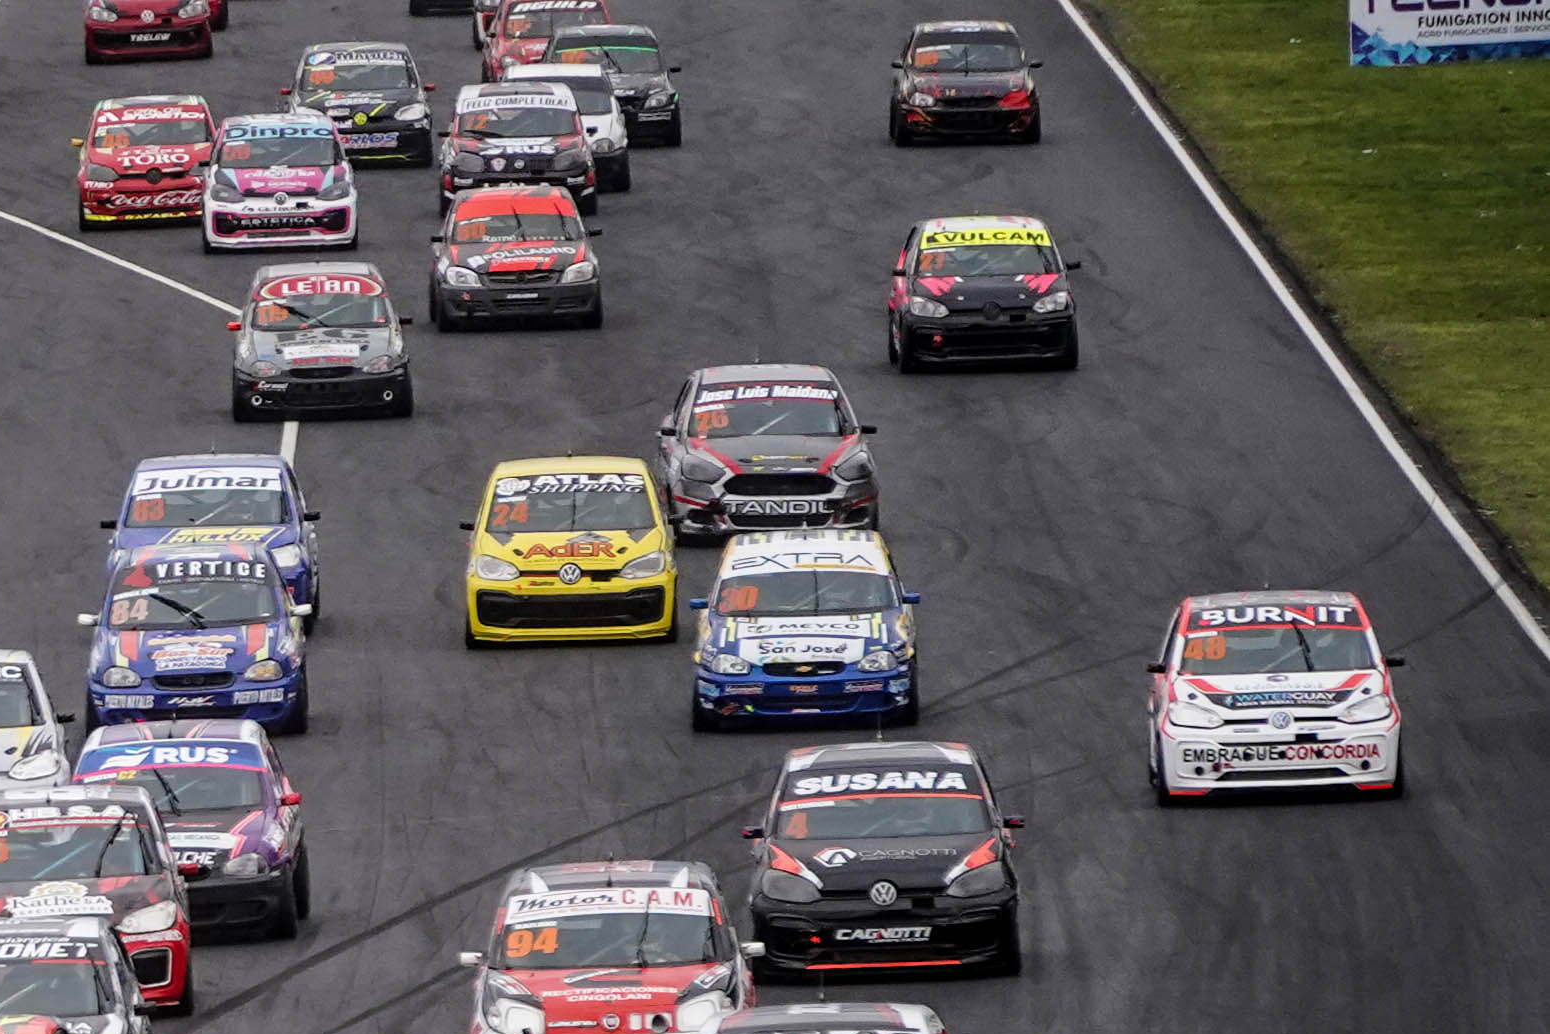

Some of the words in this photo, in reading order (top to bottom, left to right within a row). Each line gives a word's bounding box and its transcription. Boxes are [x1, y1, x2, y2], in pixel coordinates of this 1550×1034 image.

[1418, 10, 1510, 28] FUMIGATION
[495, 97, 536, 106] CUMPLE
[226, 125, 334, 138] Dinpro
[506, 145, 556, 154] RUS
[116, 153, 190, 167] TORO
[84, 181, 114, 189] TORO
[943, 232, 1044, 242] VULCAM
[697, 389, 734, 403] Jose
[736, 386, 770, 399] Luis
[534, 475, 644, 485] ATLAS
[528, 483, 643, 494] SHIPPING
[492, 503, 528, 526] 24
[723, 501, 835, 514] TANDIL
[522, 541, 617, 559] AdER
[732, 553, 874, 570] EXTRA
[156, 560, 266, 578] VERTICE
[111, 598, 149, 625] 84
[759, 642, 796, 655] San
[153, 747, 229, 763] RUS
[794, 771, 968, 795] SUSANA
[517, 893, 614, 912] Motor
[835, 926, 933, 940] CAGNOTTI
[506, 927, 559, 958] 94
[542, 986, 678, 997] RECTIFICACIONES
[566, 993, 652, 1002] CINGOLANI
